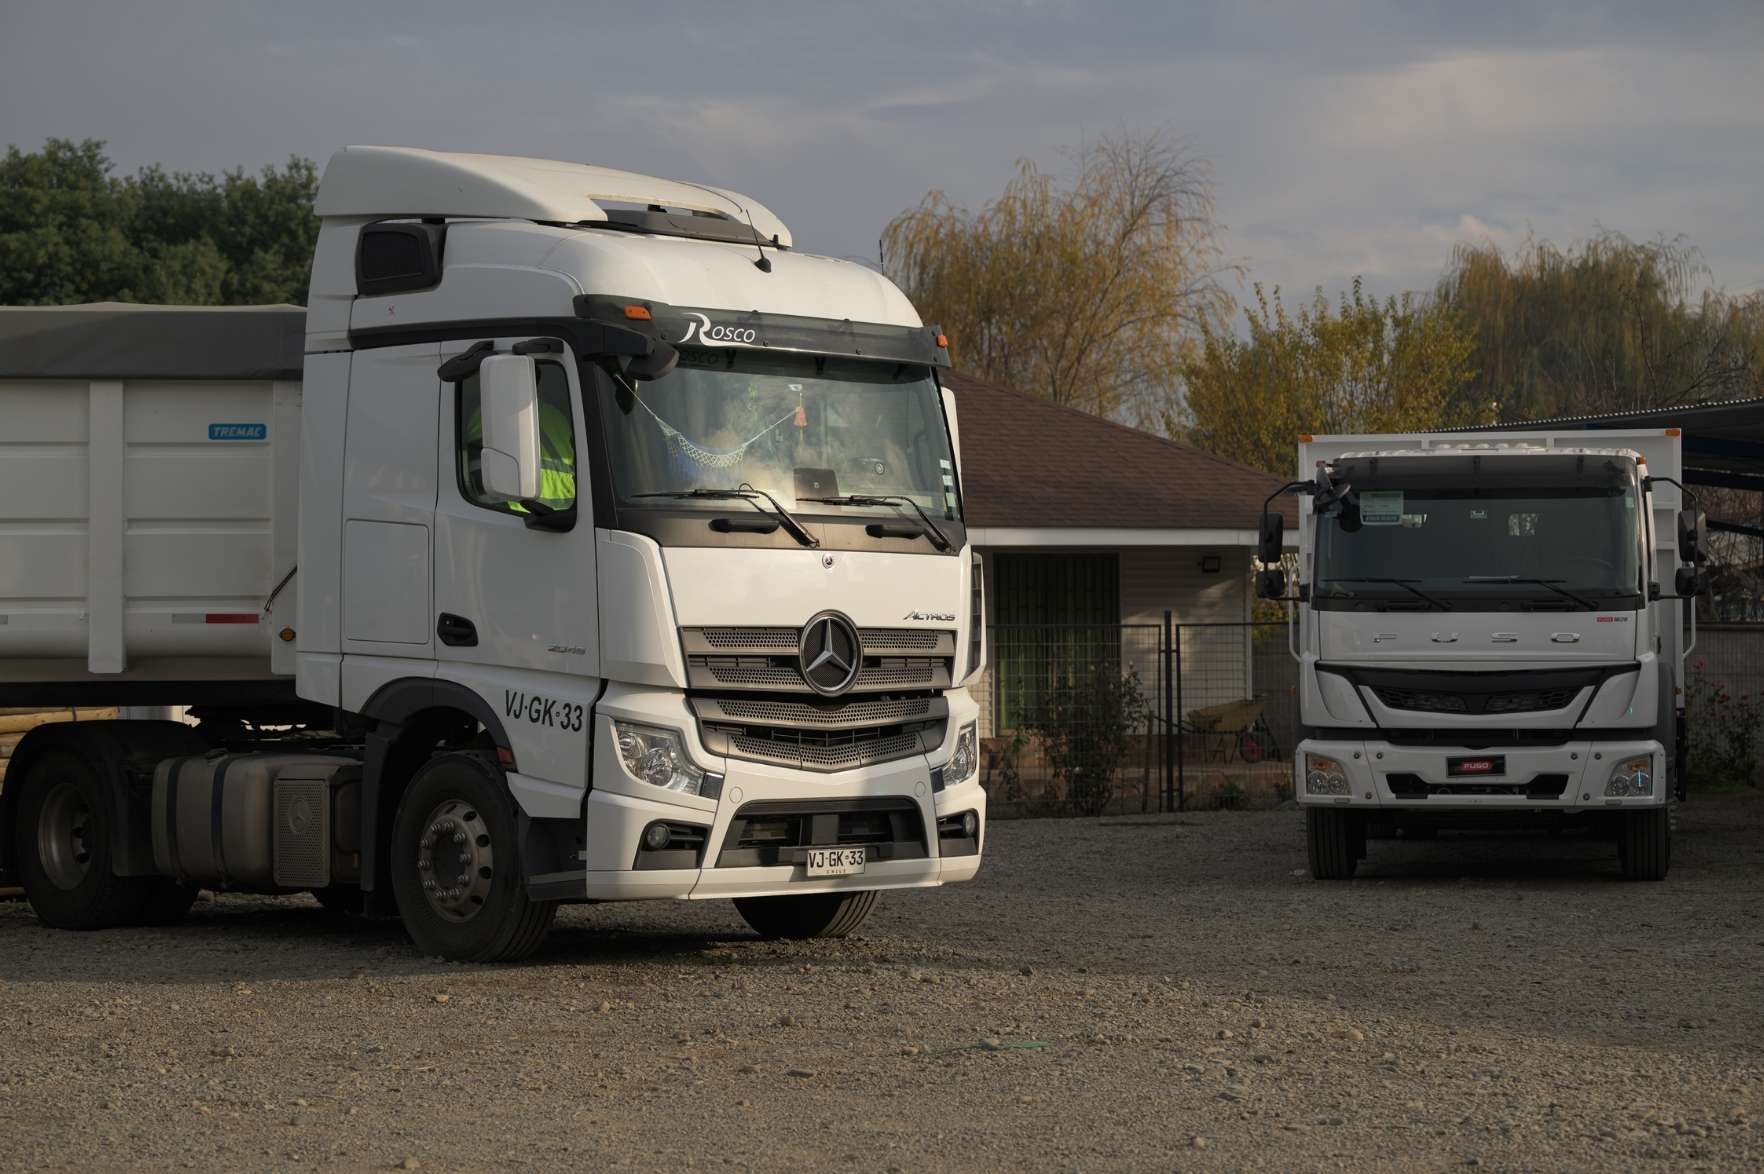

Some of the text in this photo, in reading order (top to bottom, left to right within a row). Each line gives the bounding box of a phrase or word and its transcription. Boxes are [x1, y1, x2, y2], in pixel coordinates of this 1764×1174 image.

[213, 426, 263, 438] TREMAC
[903, 611, 956, 621] ACTROS
[1372, 631, 1581, 644] FUSO
